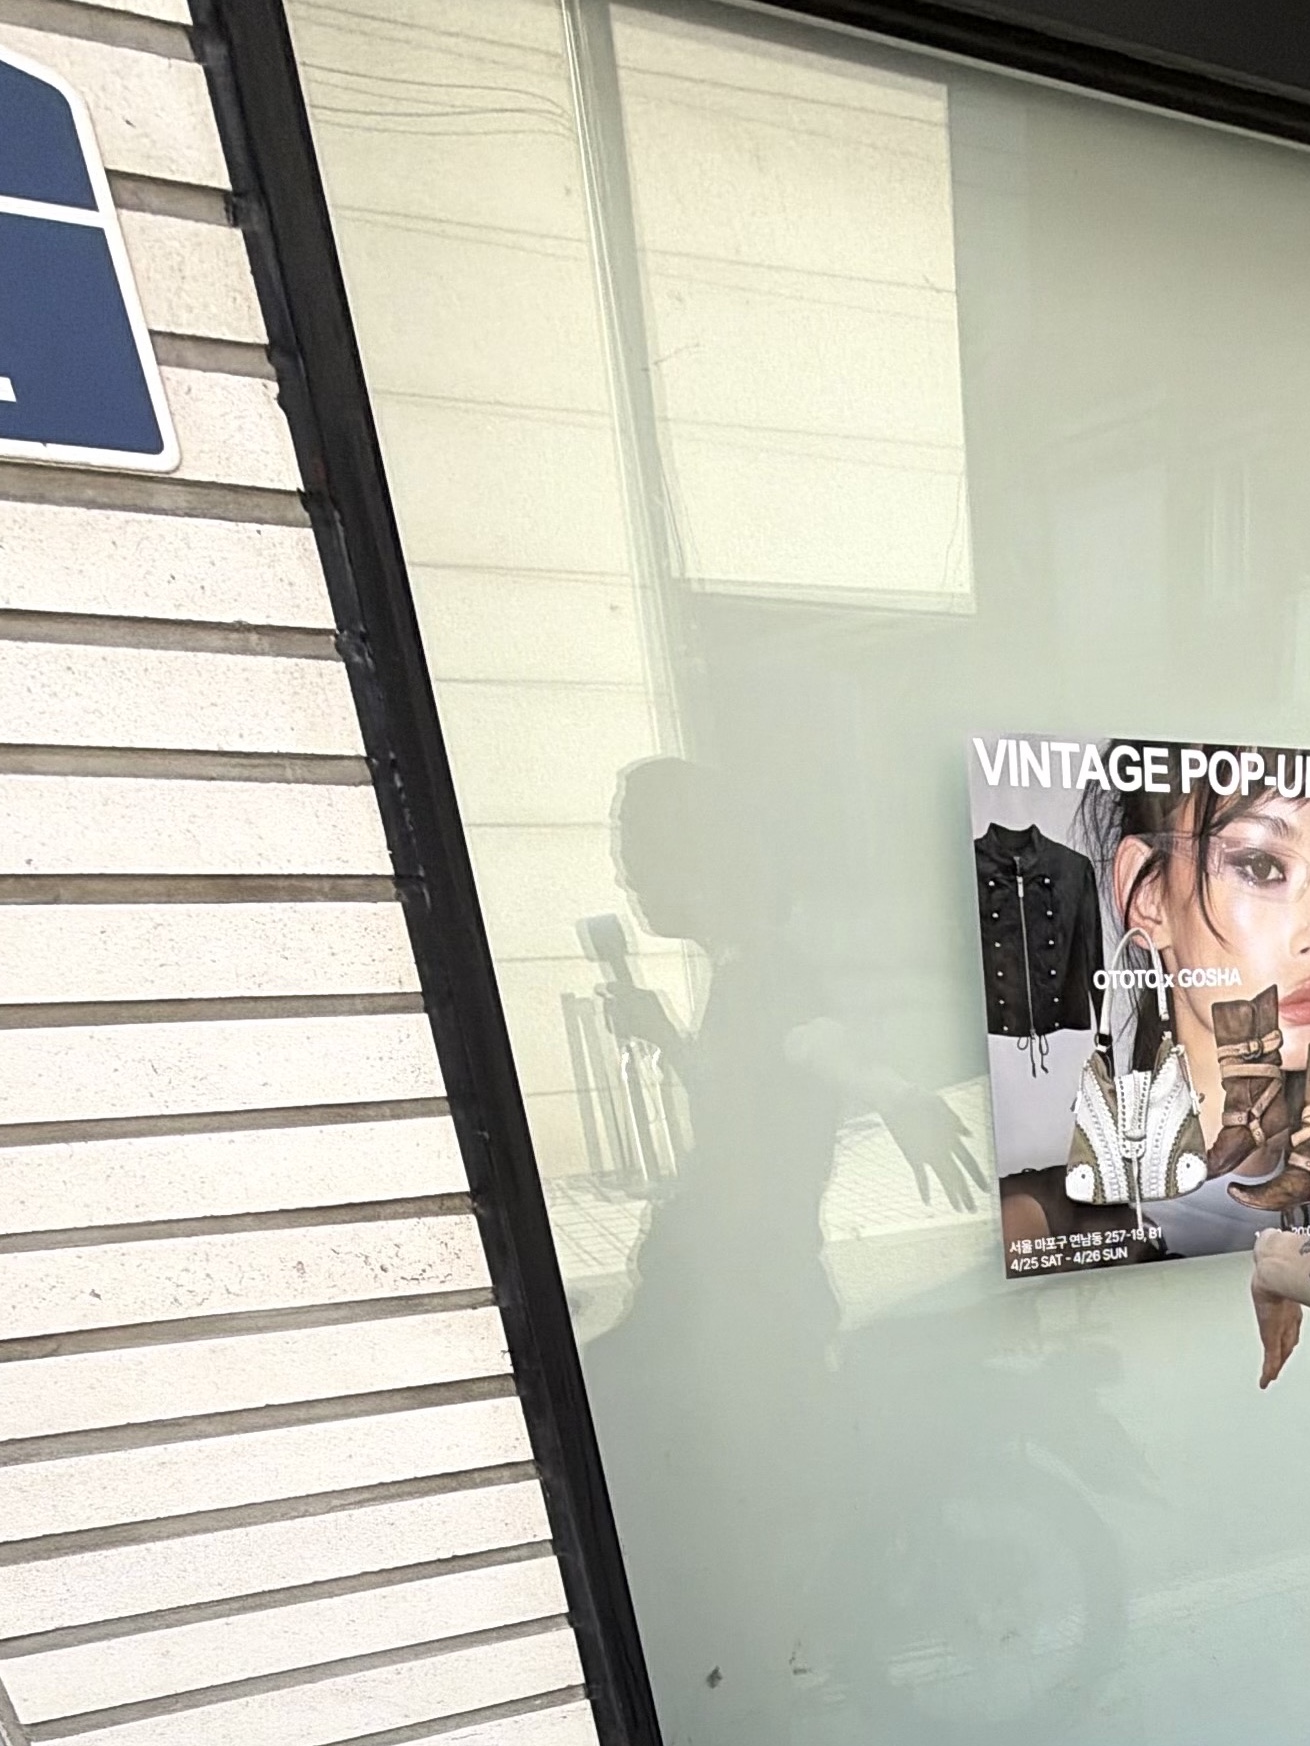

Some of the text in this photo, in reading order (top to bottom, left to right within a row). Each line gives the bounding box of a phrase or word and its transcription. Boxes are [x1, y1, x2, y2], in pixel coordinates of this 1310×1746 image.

[973, 738, 1171, 793] VINTAGE
[1093, 967, 1243, 990] OTOTO x GOSHA
[1010, 1226, 1163, 1254] 서울 마포구 연남동 257-19, B1
[1010, 1257, 1039, 1272] 4/25
[1040, 1253, 1064, 1268] SAT
[1073, 1250, 1101, 1265] 4/26
[1102, 1246, 1129, 1261] SUN
